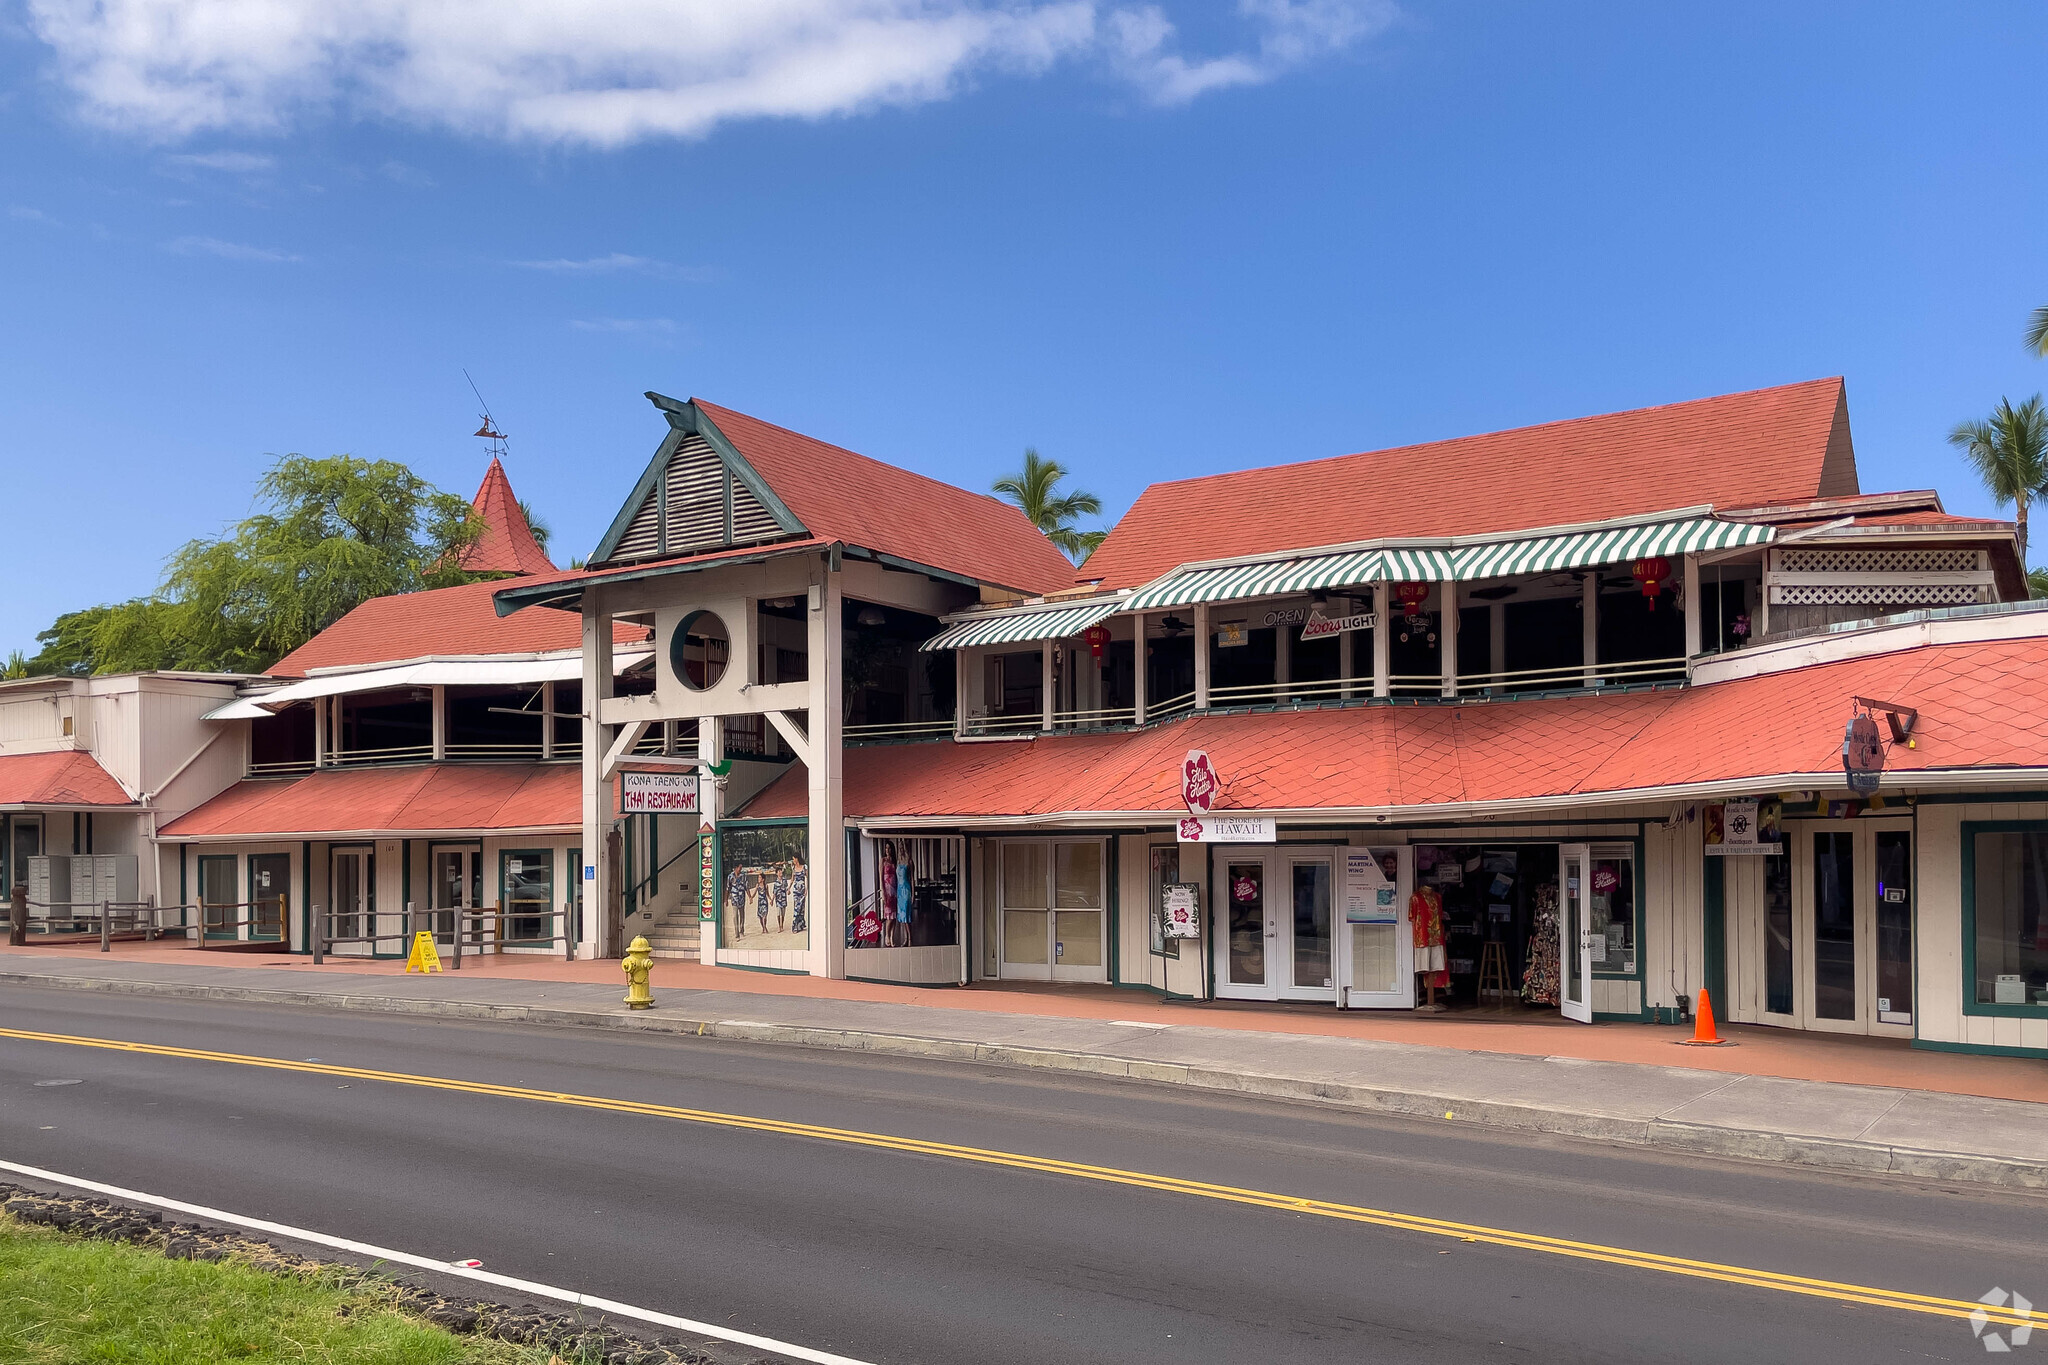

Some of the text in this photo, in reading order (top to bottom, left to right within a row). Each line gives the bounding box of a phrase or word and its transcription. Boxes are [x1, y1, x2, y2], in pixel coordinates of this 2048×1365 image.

[1264, 609, 1305, 626] OPEN
[1305, 615, 1376, 635] Coors LIGHT
[628, 775, 651, 786] KONA
[1191, 767, 1207, 783] Hilo
[1190, 780, 1211, 798] Hattie
[625, 790, 696, 810] THAI RESTAURANT
[1213, 816, 1227, 824] THE
[1229, 816, 1252, 824] STORE
[1596, 872, 1611, 881] Hilo
[1595, 877, 1616, 888] Hattie
[860, 919, 875, 928] Hilo
[859, 925, 879, 936] Hattie
